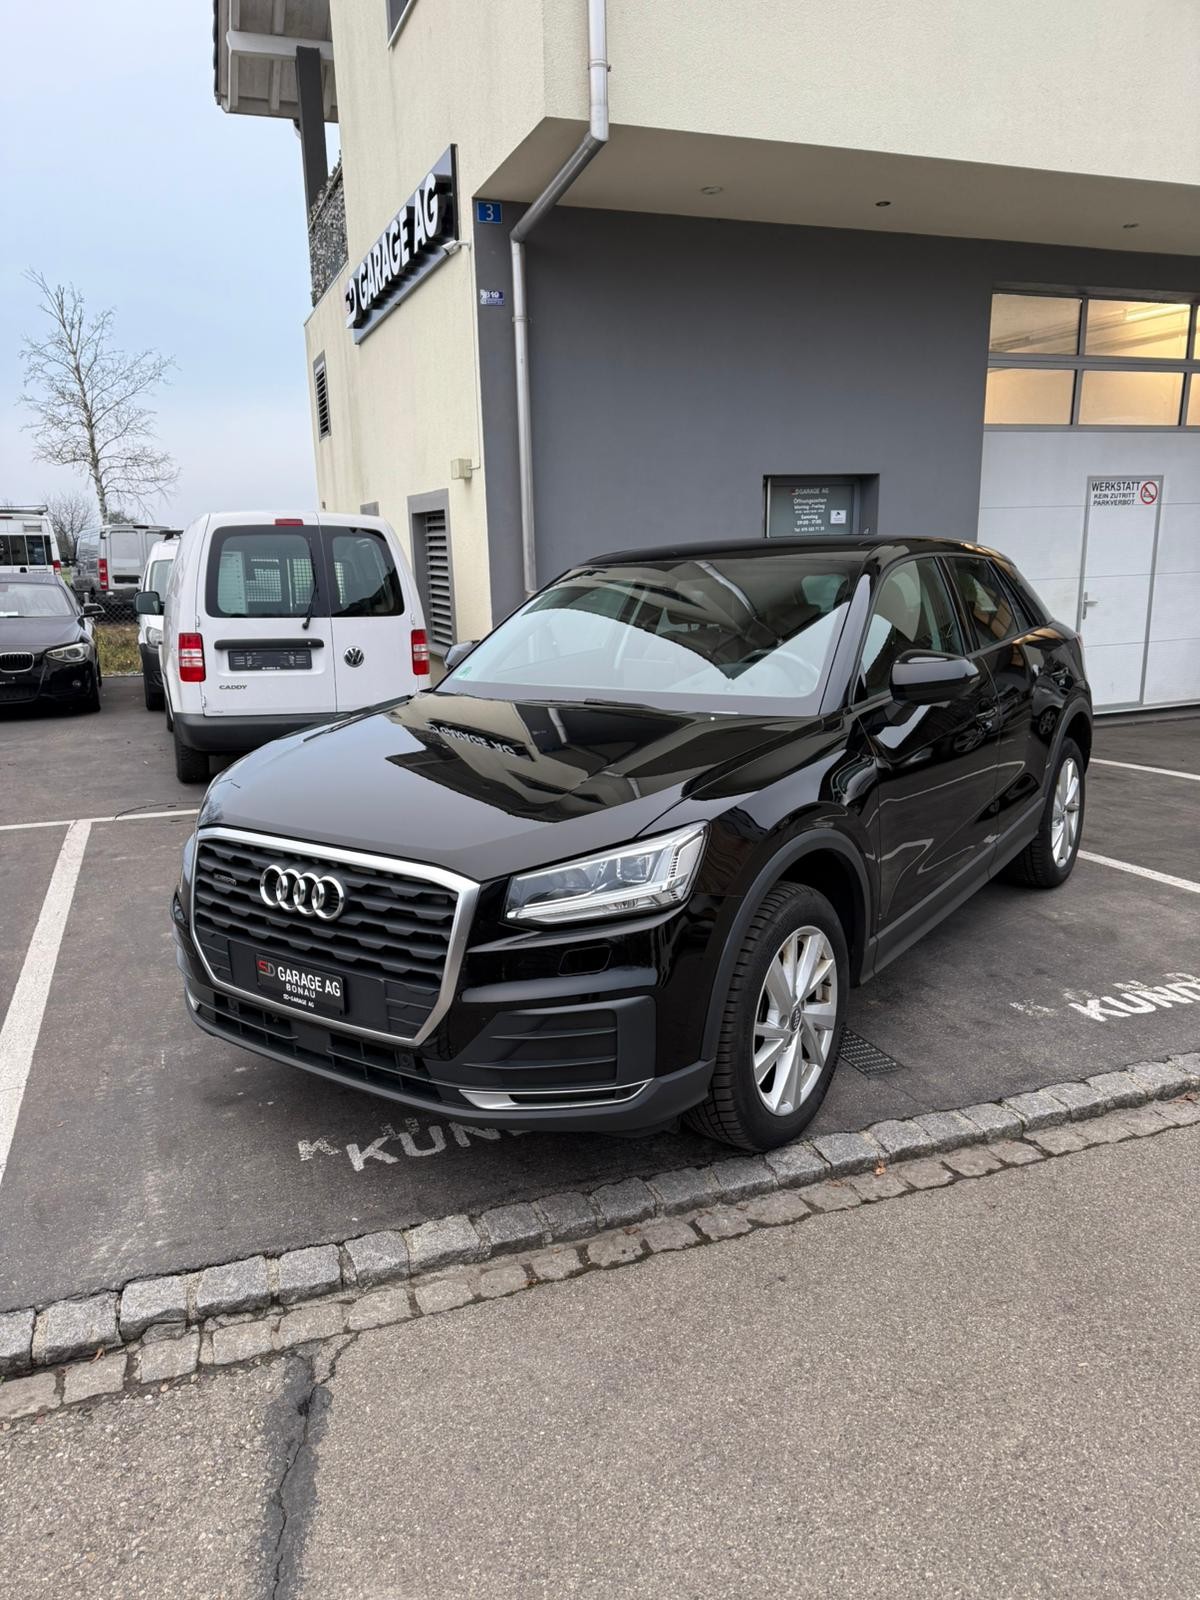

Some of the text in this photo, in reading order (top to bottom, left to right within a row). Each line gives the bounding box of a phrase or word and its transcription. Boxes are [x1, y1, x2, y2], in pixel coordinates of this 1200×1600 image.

[484, 203, 495, 222] 3
[358, 204, 411, 311] GARAGE
[413, 172, 439, 254] AG
[1091, 481, 1141, 492] WERKSTATT
[277, 966, 323, 992] GARAGE
[324, 979, 341, 997] AG
[285, 983, 316, 998] BONAU
